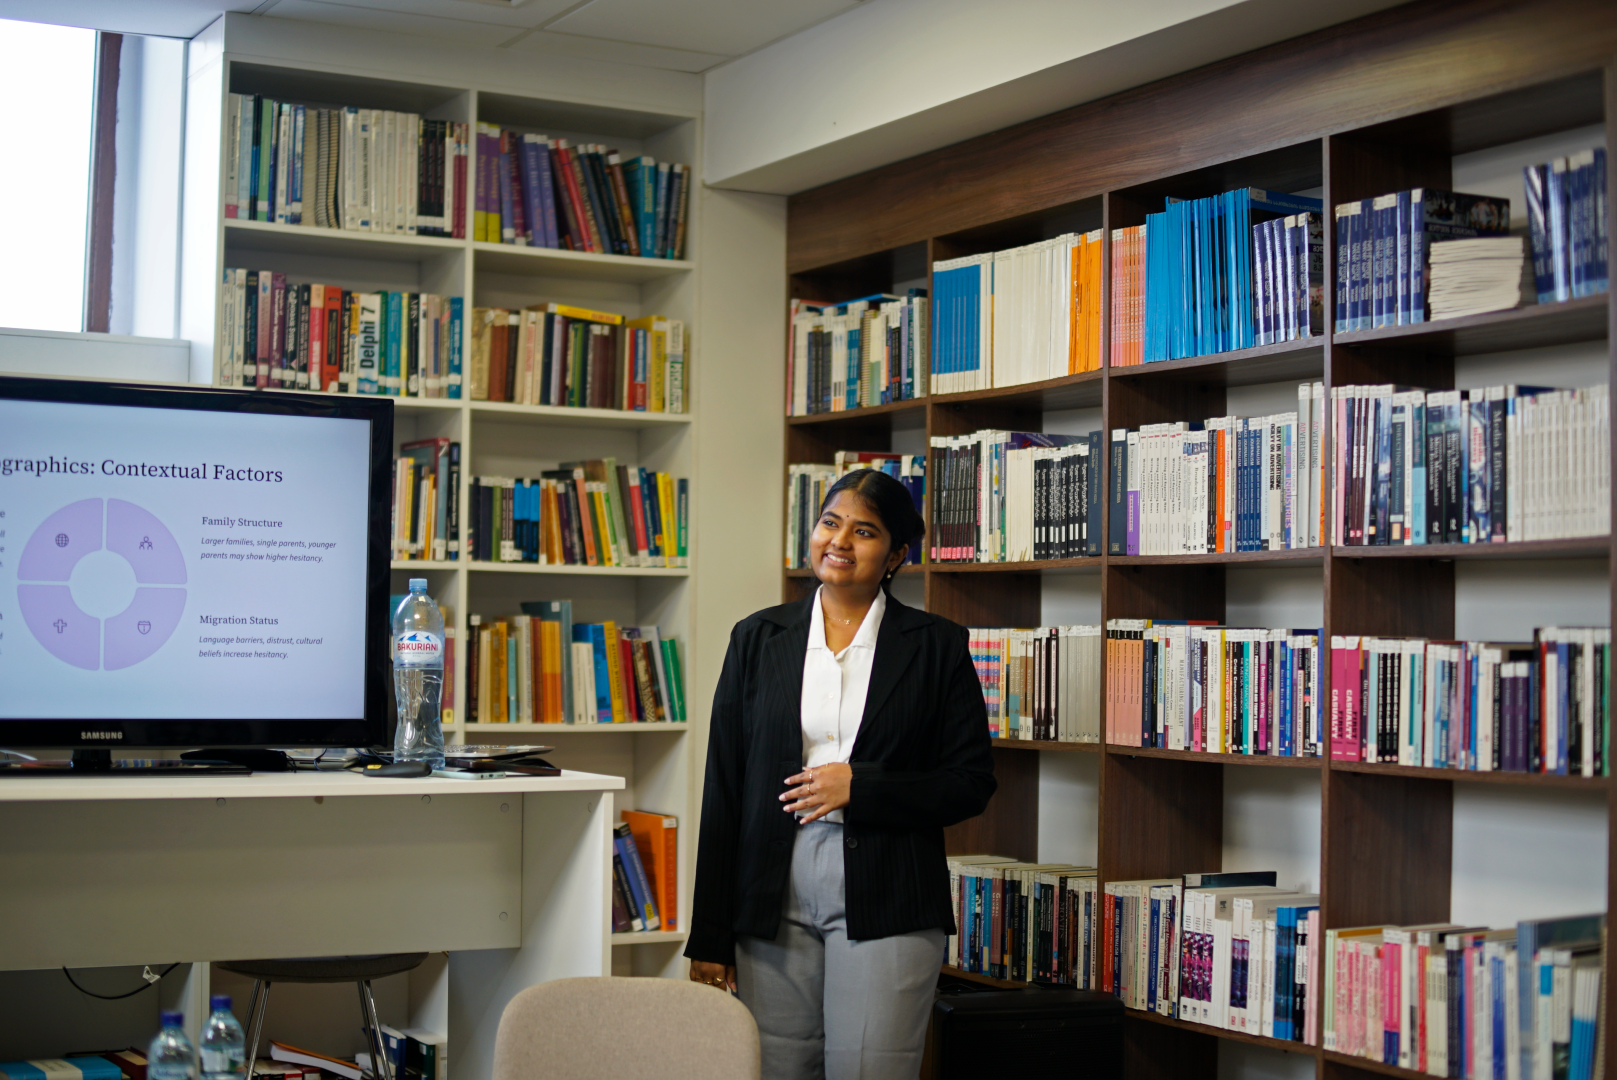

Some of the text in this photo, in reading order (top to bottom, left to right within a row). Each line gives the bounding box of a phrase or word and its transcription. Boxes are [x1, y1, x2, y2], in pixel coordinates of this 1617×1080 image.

[360, 306, 378, 368] Delphi 7
[1276, 444, 1281, 452] ON
[1493, 411, 1502, 491] Media Effects
[0, 456, 283, 483] graphics: Contextual Factors
[201, 516, 283, 528] Family Structure
[201, 537, 337, 550] Larger families, single parents, younger
[200, 552, 324, 564] parents may show higher hesitancy.
[199, 615, 279, 627] Migration Status
[199, 636, 323, 646] Language barriers, distrust, cultural
[398, 643, 438, 651] BAKURIANI
[198, 650, 288, 660] beliefs increase hesitancy.
[1363, 680, 1368, 690] On
[1298, 720, 1302, 730] OF
[80, 731, 123, 739] SAMSUNG
